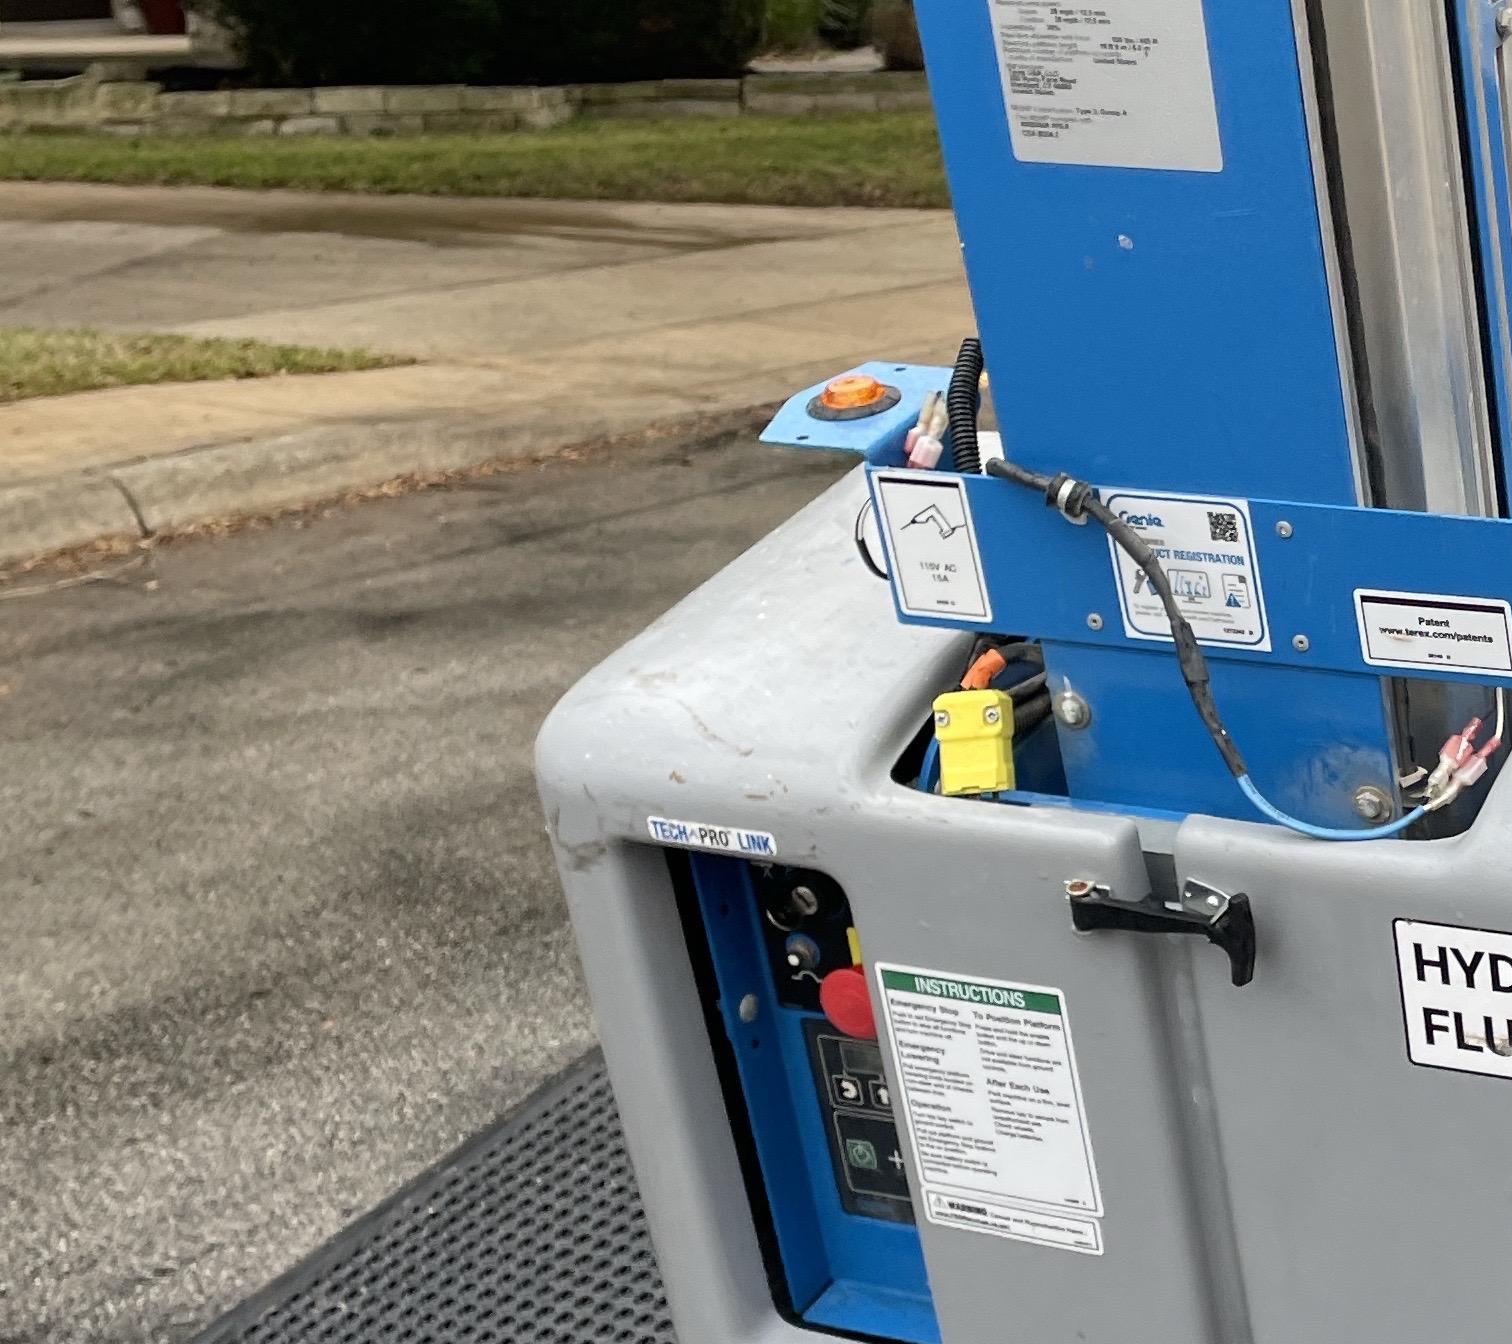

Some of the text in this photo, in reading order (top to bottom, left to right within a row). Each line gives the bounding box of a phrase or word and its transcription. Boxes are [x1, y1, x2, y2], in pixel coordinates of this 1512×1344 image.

[1174, 549, 1245, 566] REGISTRATION
[1418, 616, 1450, 628] Patent
[651, 820, 774, 856] TECH PRO LINK
[914, 976, 1026, 1009] INSTRUCTIONS
